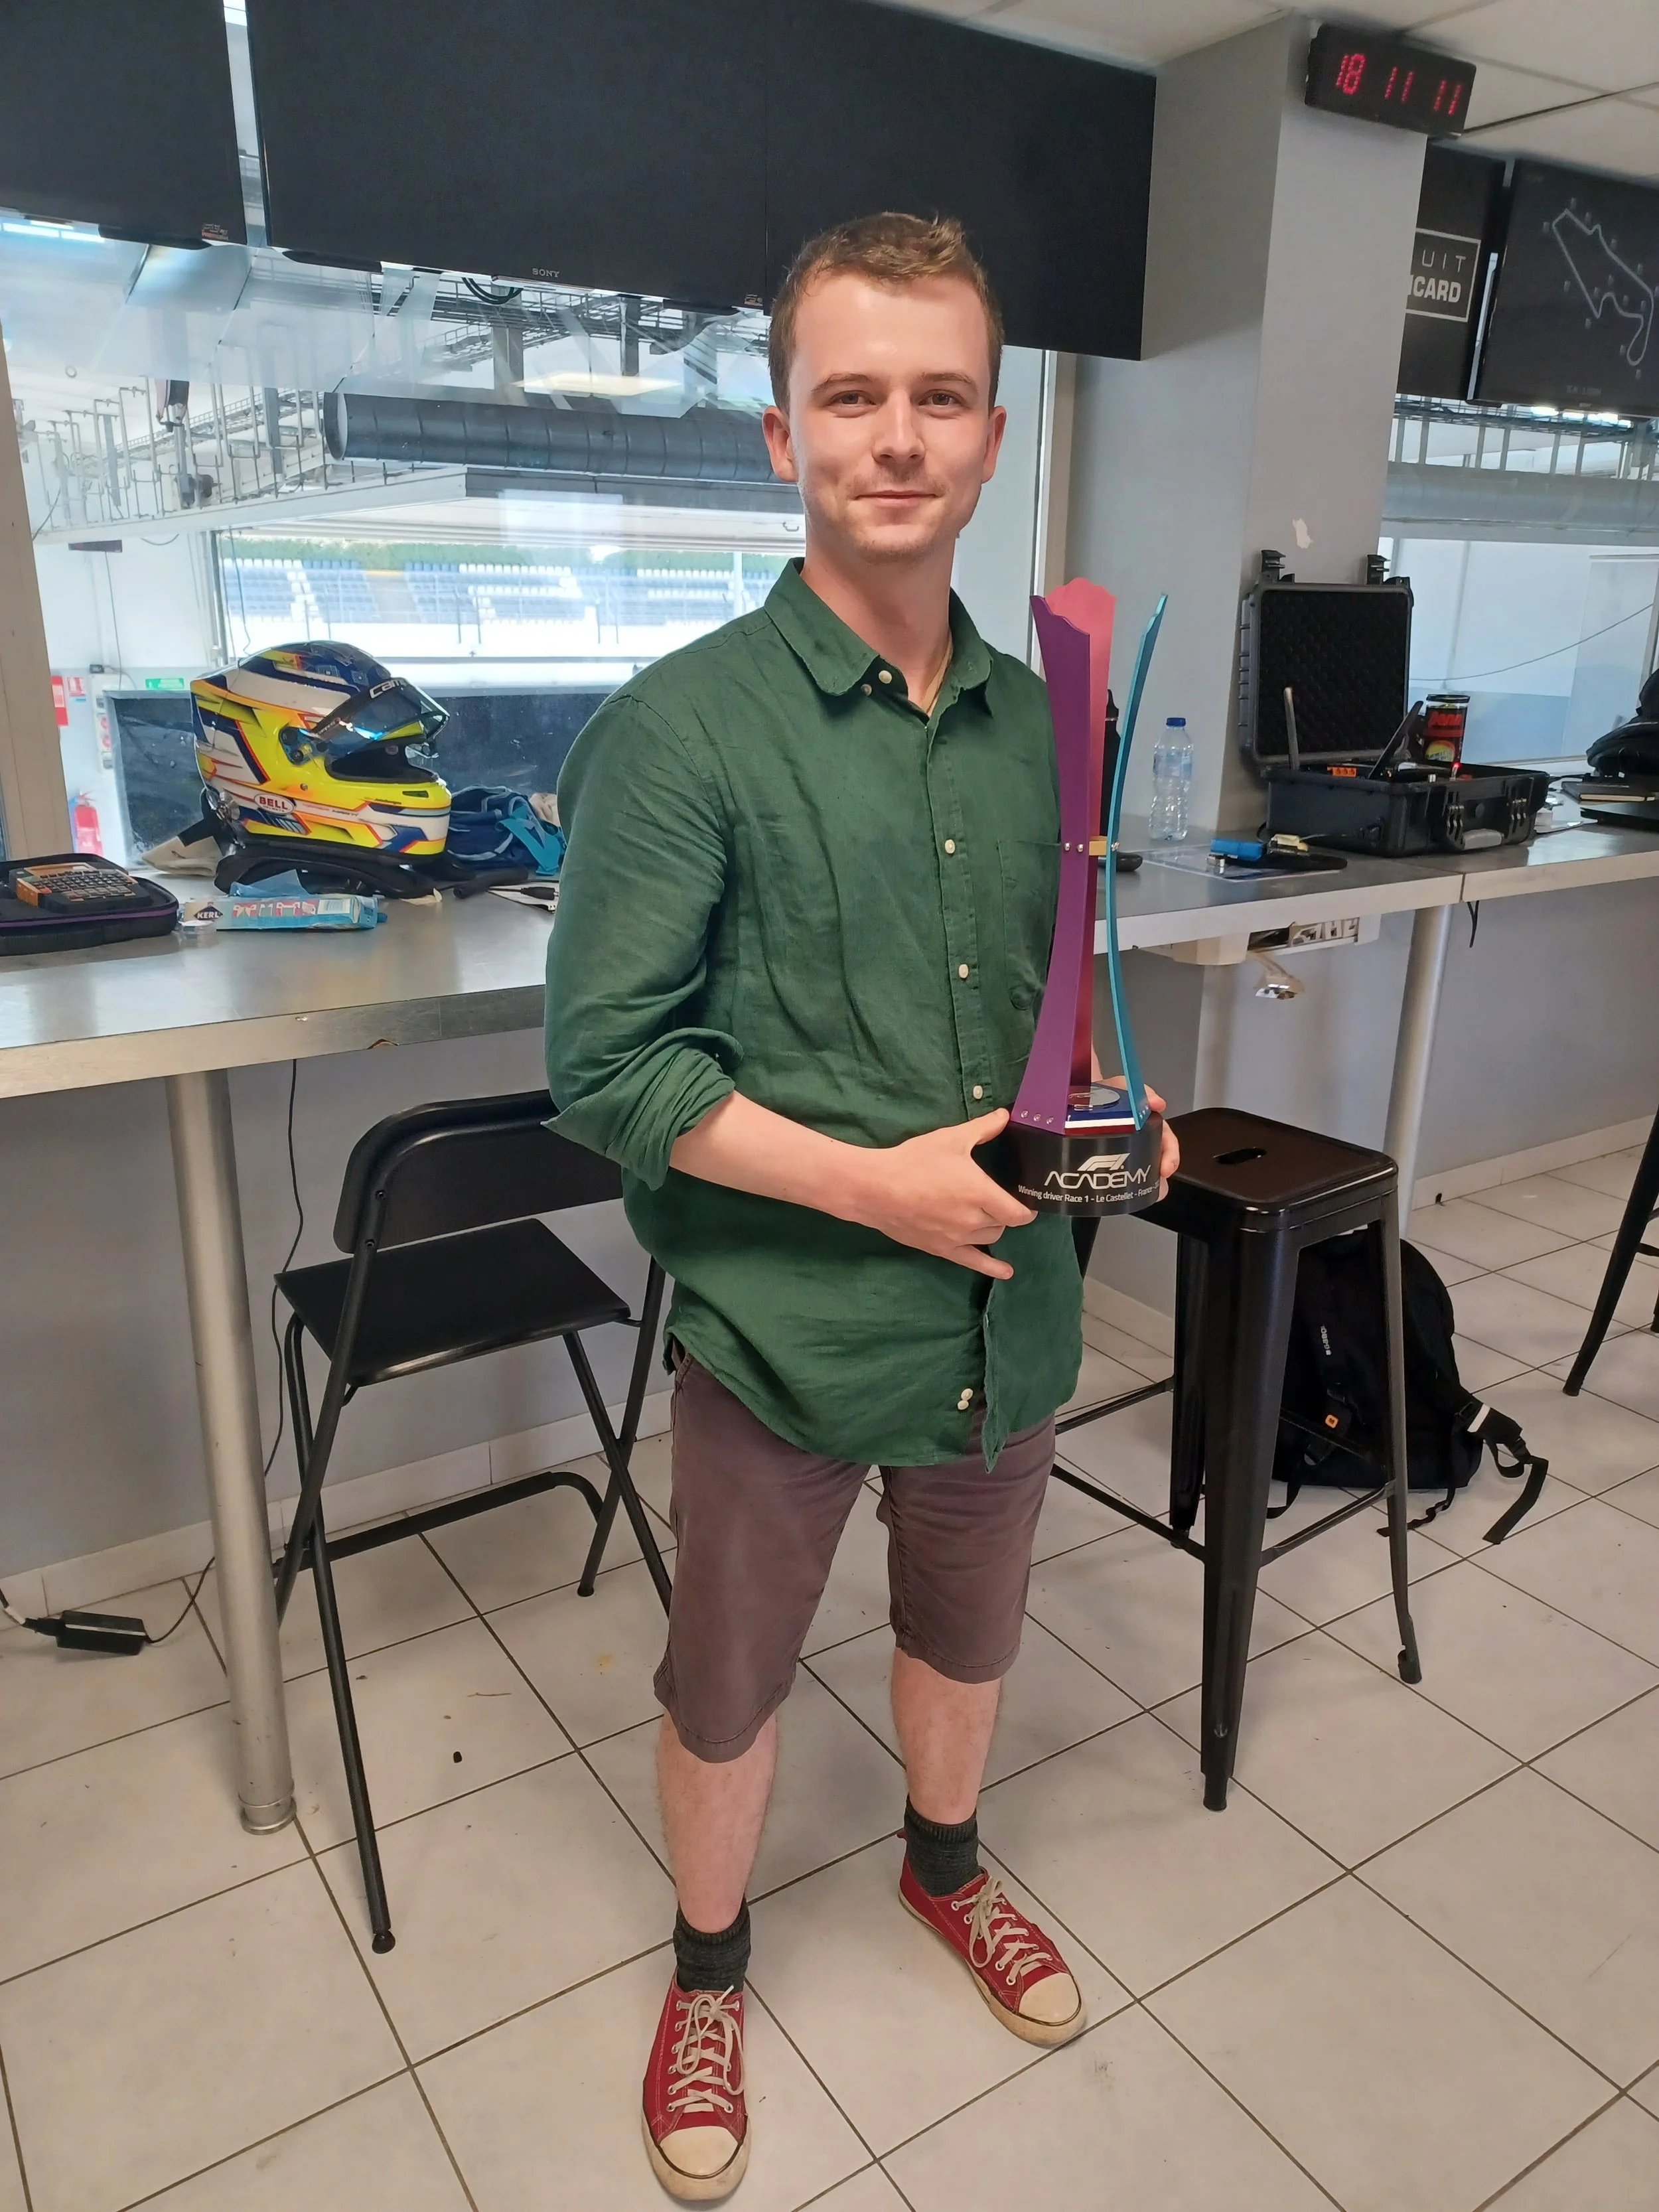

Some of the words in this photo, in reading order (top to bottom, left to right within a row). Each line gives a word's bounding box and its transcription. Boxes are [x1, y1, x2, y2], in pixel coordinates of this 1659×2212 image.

[1336, 53, 1366, 95] 18
[1384, 67, 1414, 104] 11
[1433, 80, 1463, 115] 11
[1421, 249, 1467, 273] UIT
[532, 267, 560, 278] SONY
[259, 796, 288, 810] BELL
[1044, 1164, 1151, 1190] ACADEMY
[1018, 1185, 1043, 1200] Winning
[1043, 1191, 1063, 1201] driver
[1064, 1194, 1082, 1203] Race
[1106, 1192, 1133, 1203] Castellet
[1137, 1186, 1153, 1197] France
